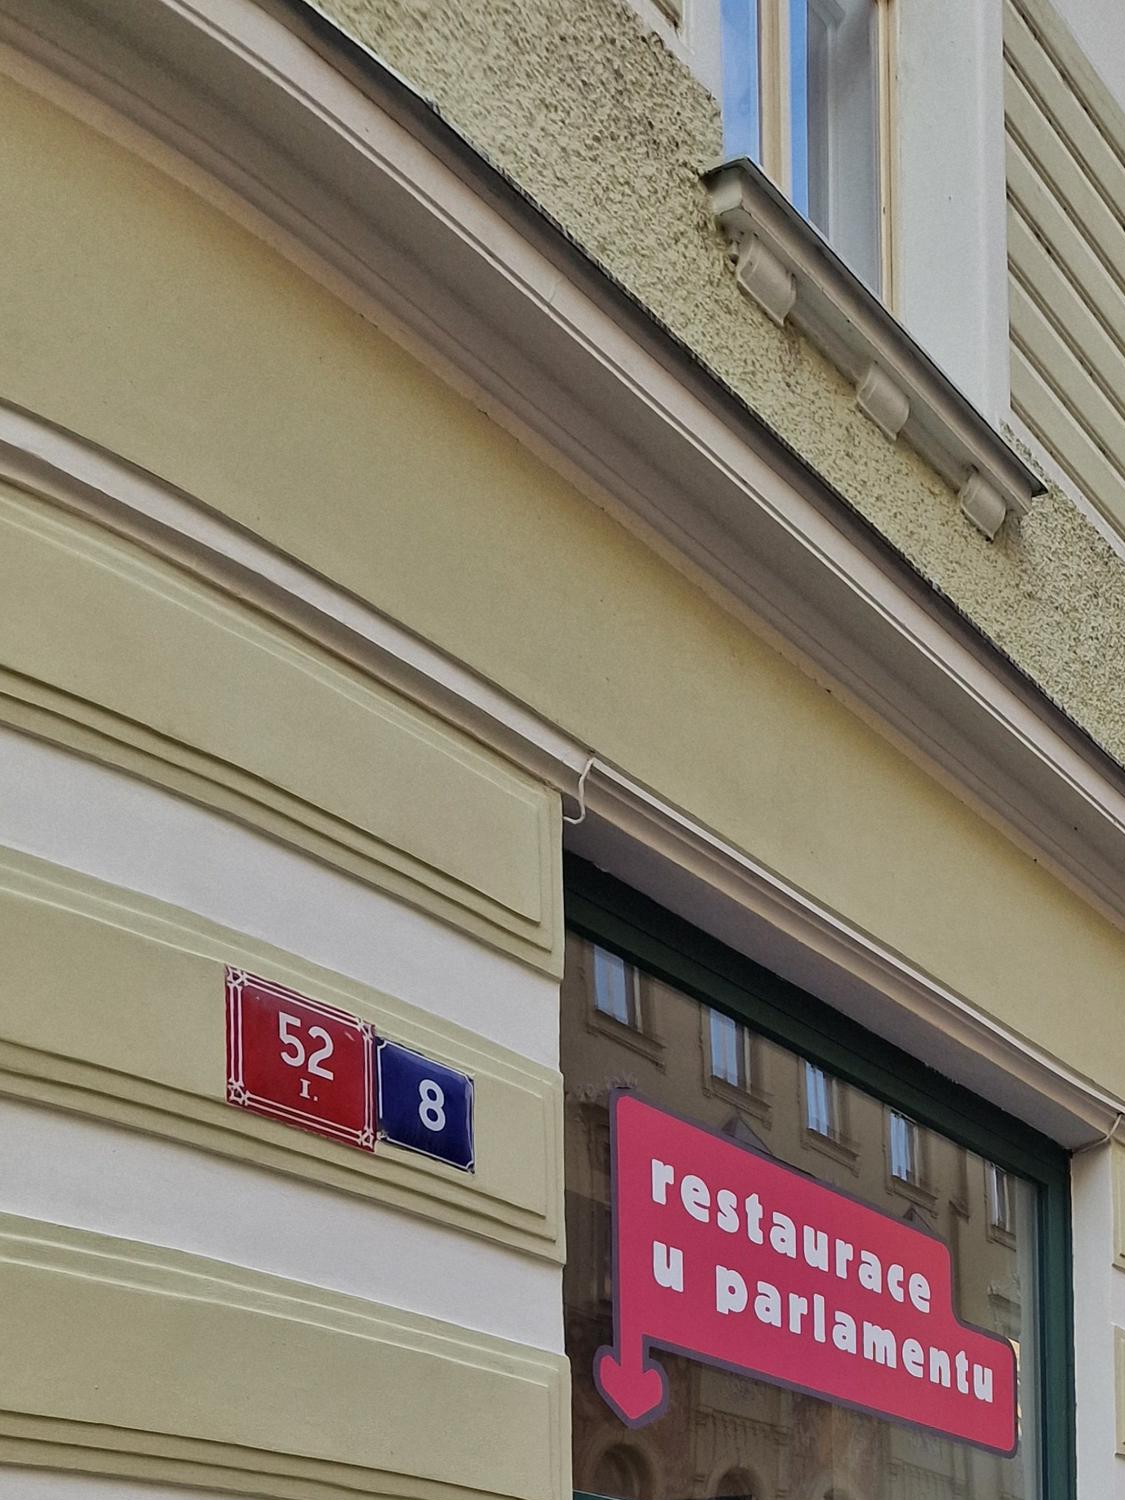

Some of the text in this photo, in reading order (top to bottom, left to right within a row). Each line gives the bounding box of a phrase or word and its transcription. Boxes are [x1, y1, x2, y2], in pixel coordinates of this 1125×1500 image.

[278, 1011, 334, 1081] 52
[418, 1079, 446, 1132] 8
[650, 1158, 931, 1314] restaurace
[653, 1240, 993, 1403] u parlamentu
